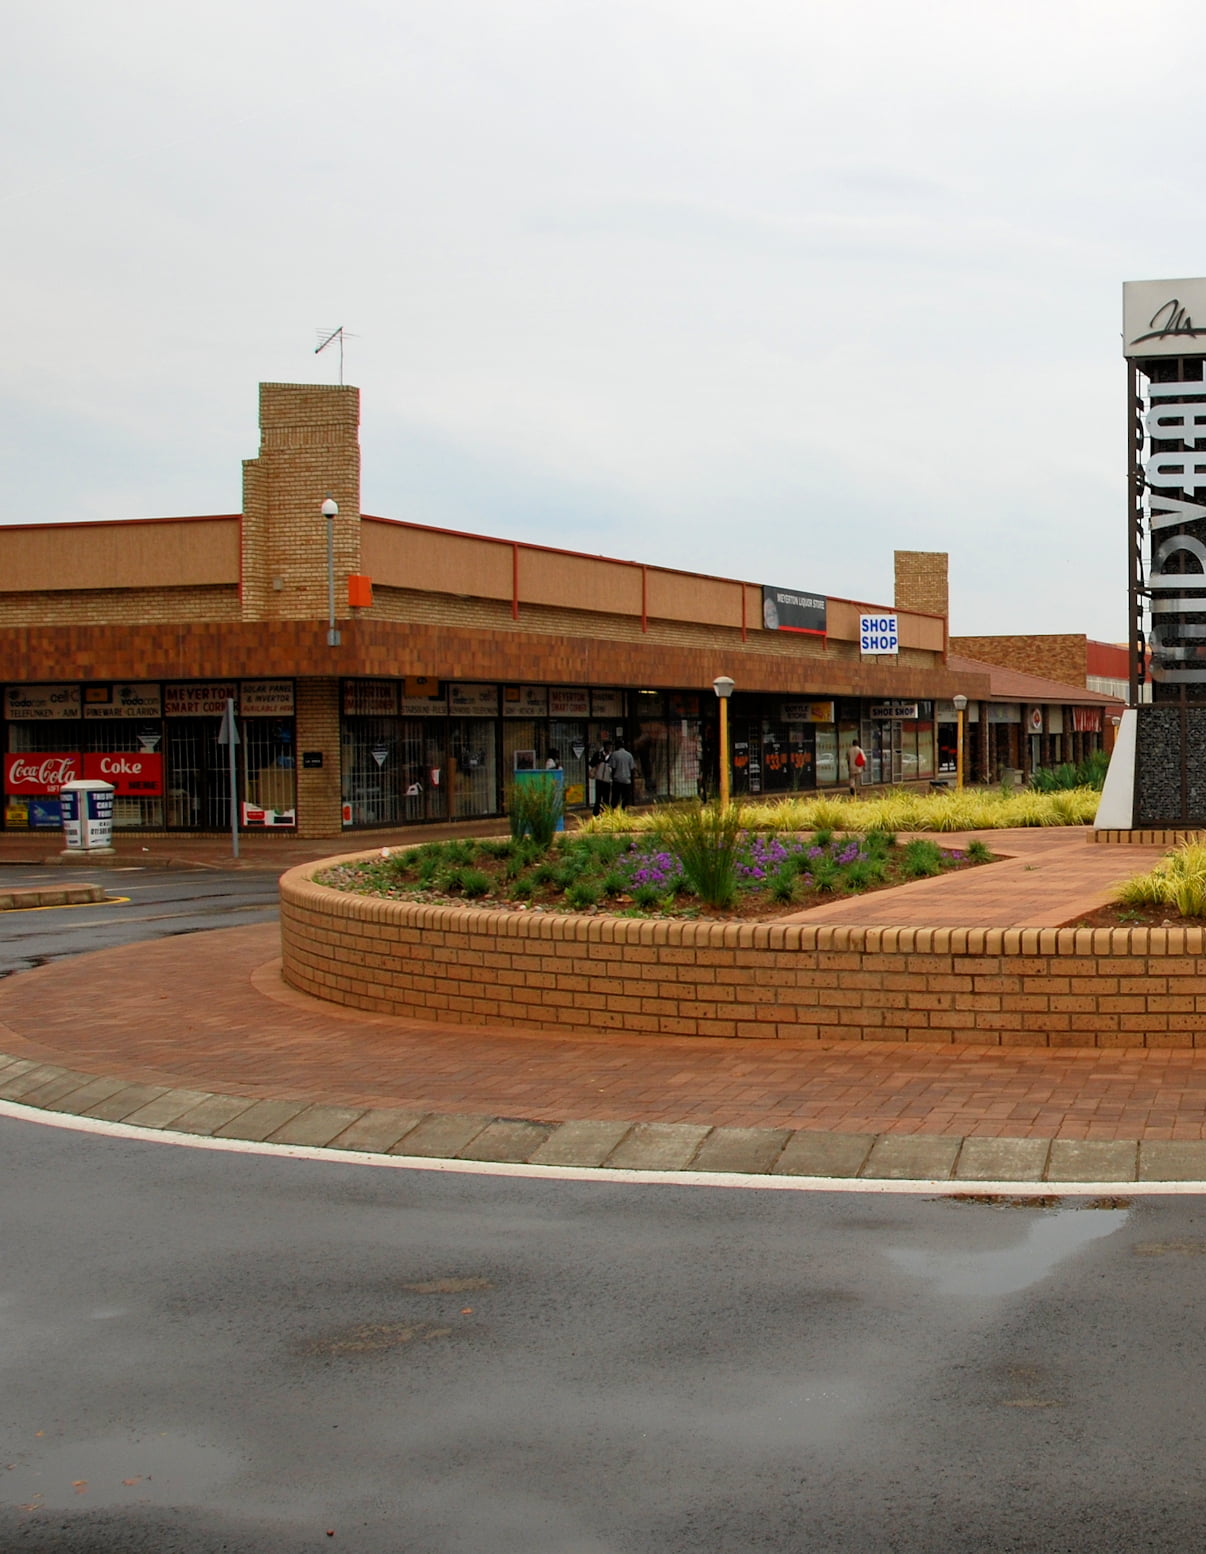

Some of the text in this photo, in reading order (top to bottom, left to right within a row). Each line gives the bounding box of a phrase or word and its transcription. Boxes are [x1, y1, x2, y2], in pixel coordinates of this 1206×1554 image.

[862, 619, 896, 632] SHOE
[862, 636, 897, 650] SHOP
[167, 687, 234, 700] MEYERTON
[165, 702, 198, 713] SMART
[100, 757, 143, 774] Coke
